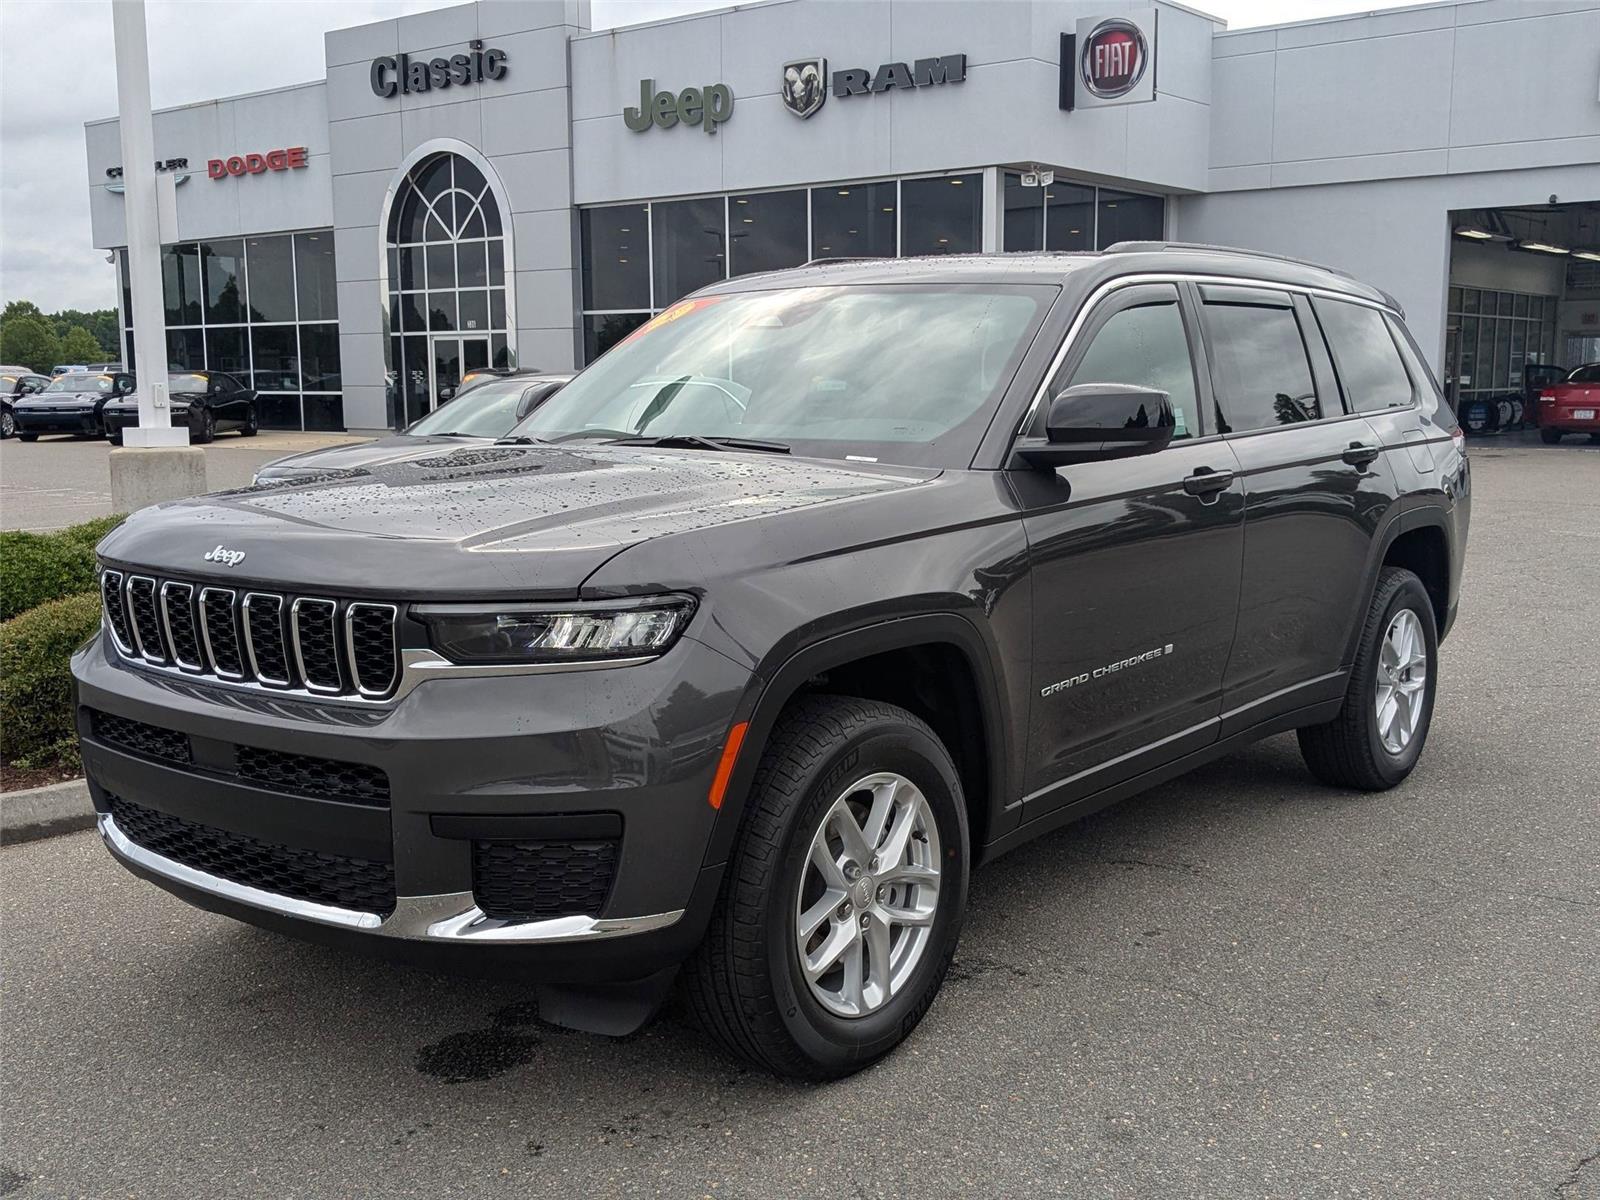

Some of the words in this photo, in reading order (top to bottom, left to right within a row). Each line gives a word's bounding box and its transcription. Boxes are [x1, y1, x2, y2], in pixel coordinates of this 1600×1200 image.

[370, 39, 508, 98] Classic
[832, 53, 967, 98] RAM
[1095, 41, 1133, 79] FIAT
[623, 79, 735, 135] Jeep
[106, 157, 188, 179] CHLER
[207, 147, 309, 180] DODGE
[204, 545, 246, 568] Jeep
[1040, 672, 1090, 698] GRAND
[1092, 647, 1163, 679] CHEROKEE
